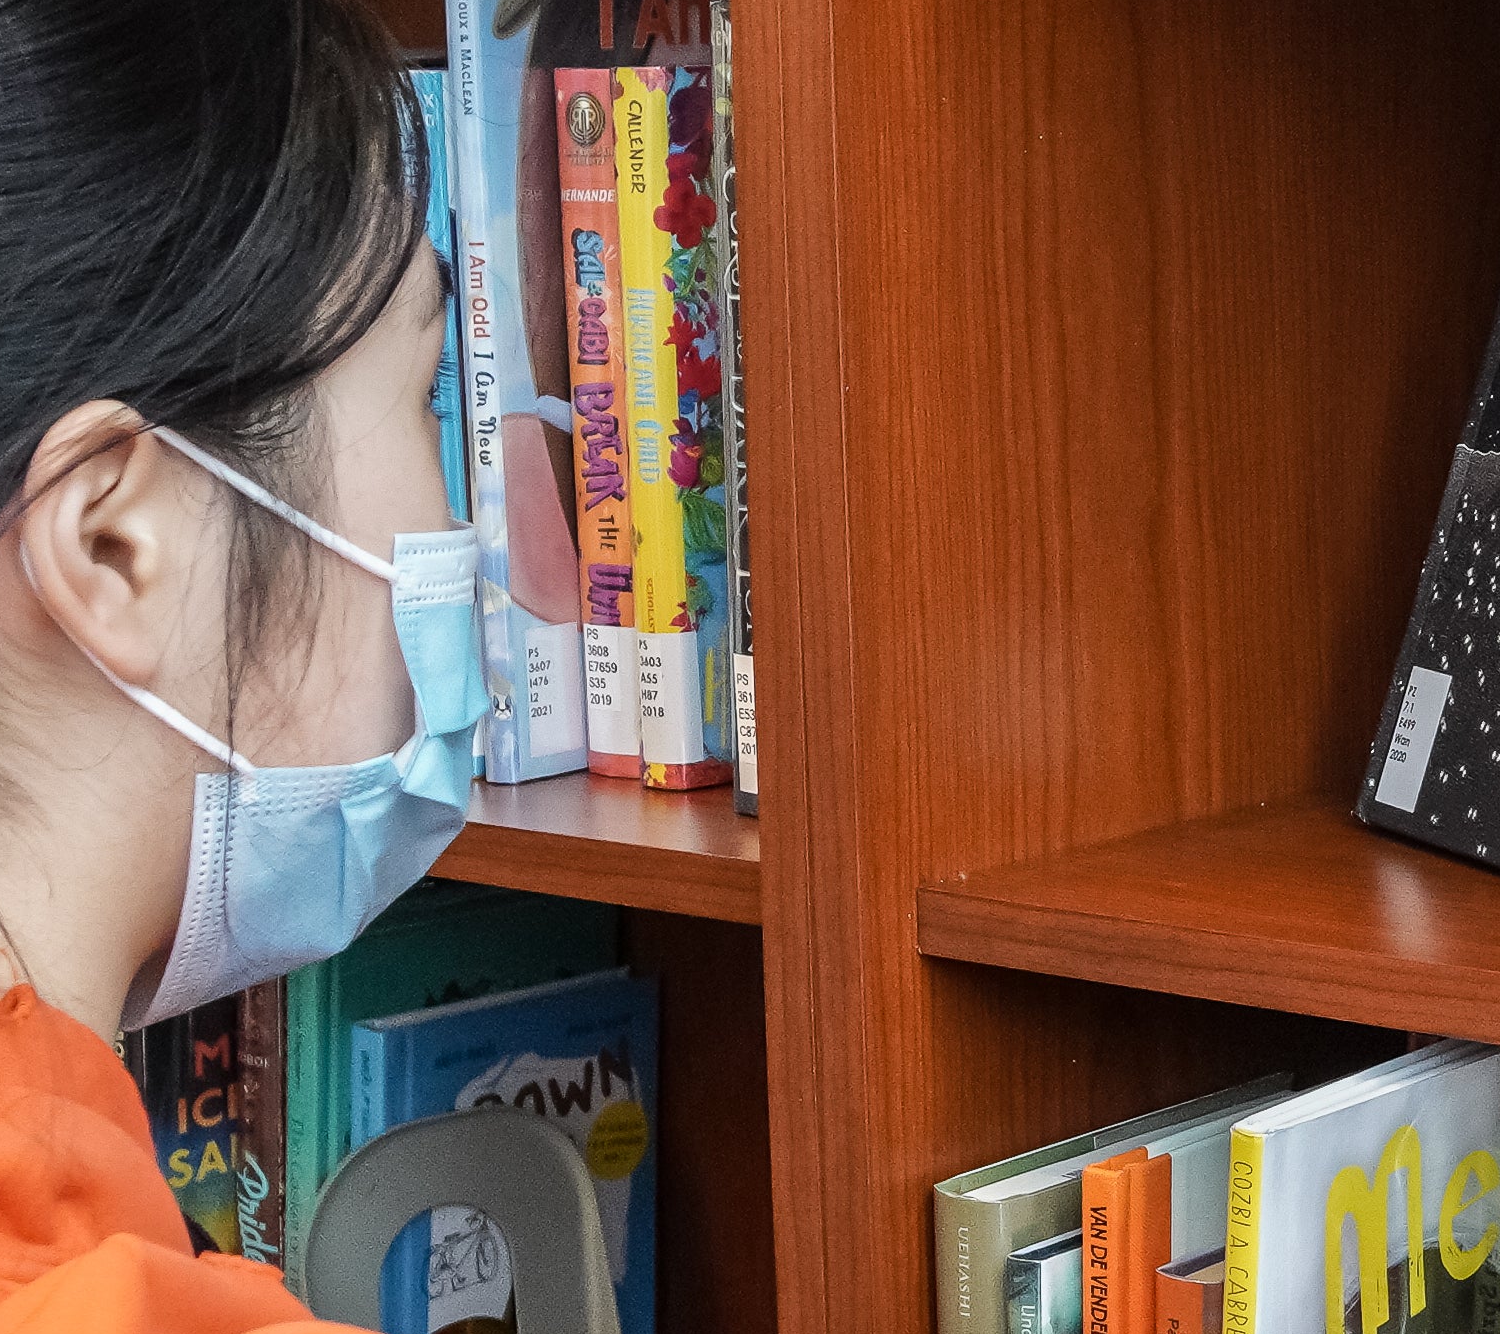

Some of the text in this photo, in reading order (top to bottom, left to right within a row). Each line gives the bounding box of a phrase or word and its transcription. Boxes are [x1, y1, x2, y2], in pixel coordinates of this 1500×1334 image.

[628, 99, 647, 194] CALLENDER
[573, 382, 627, 512] BREAK
[587, 645, 609, 657] 3608
[590, 693, 612, 705] 2019
[642, 706, 664, 718] 2018
